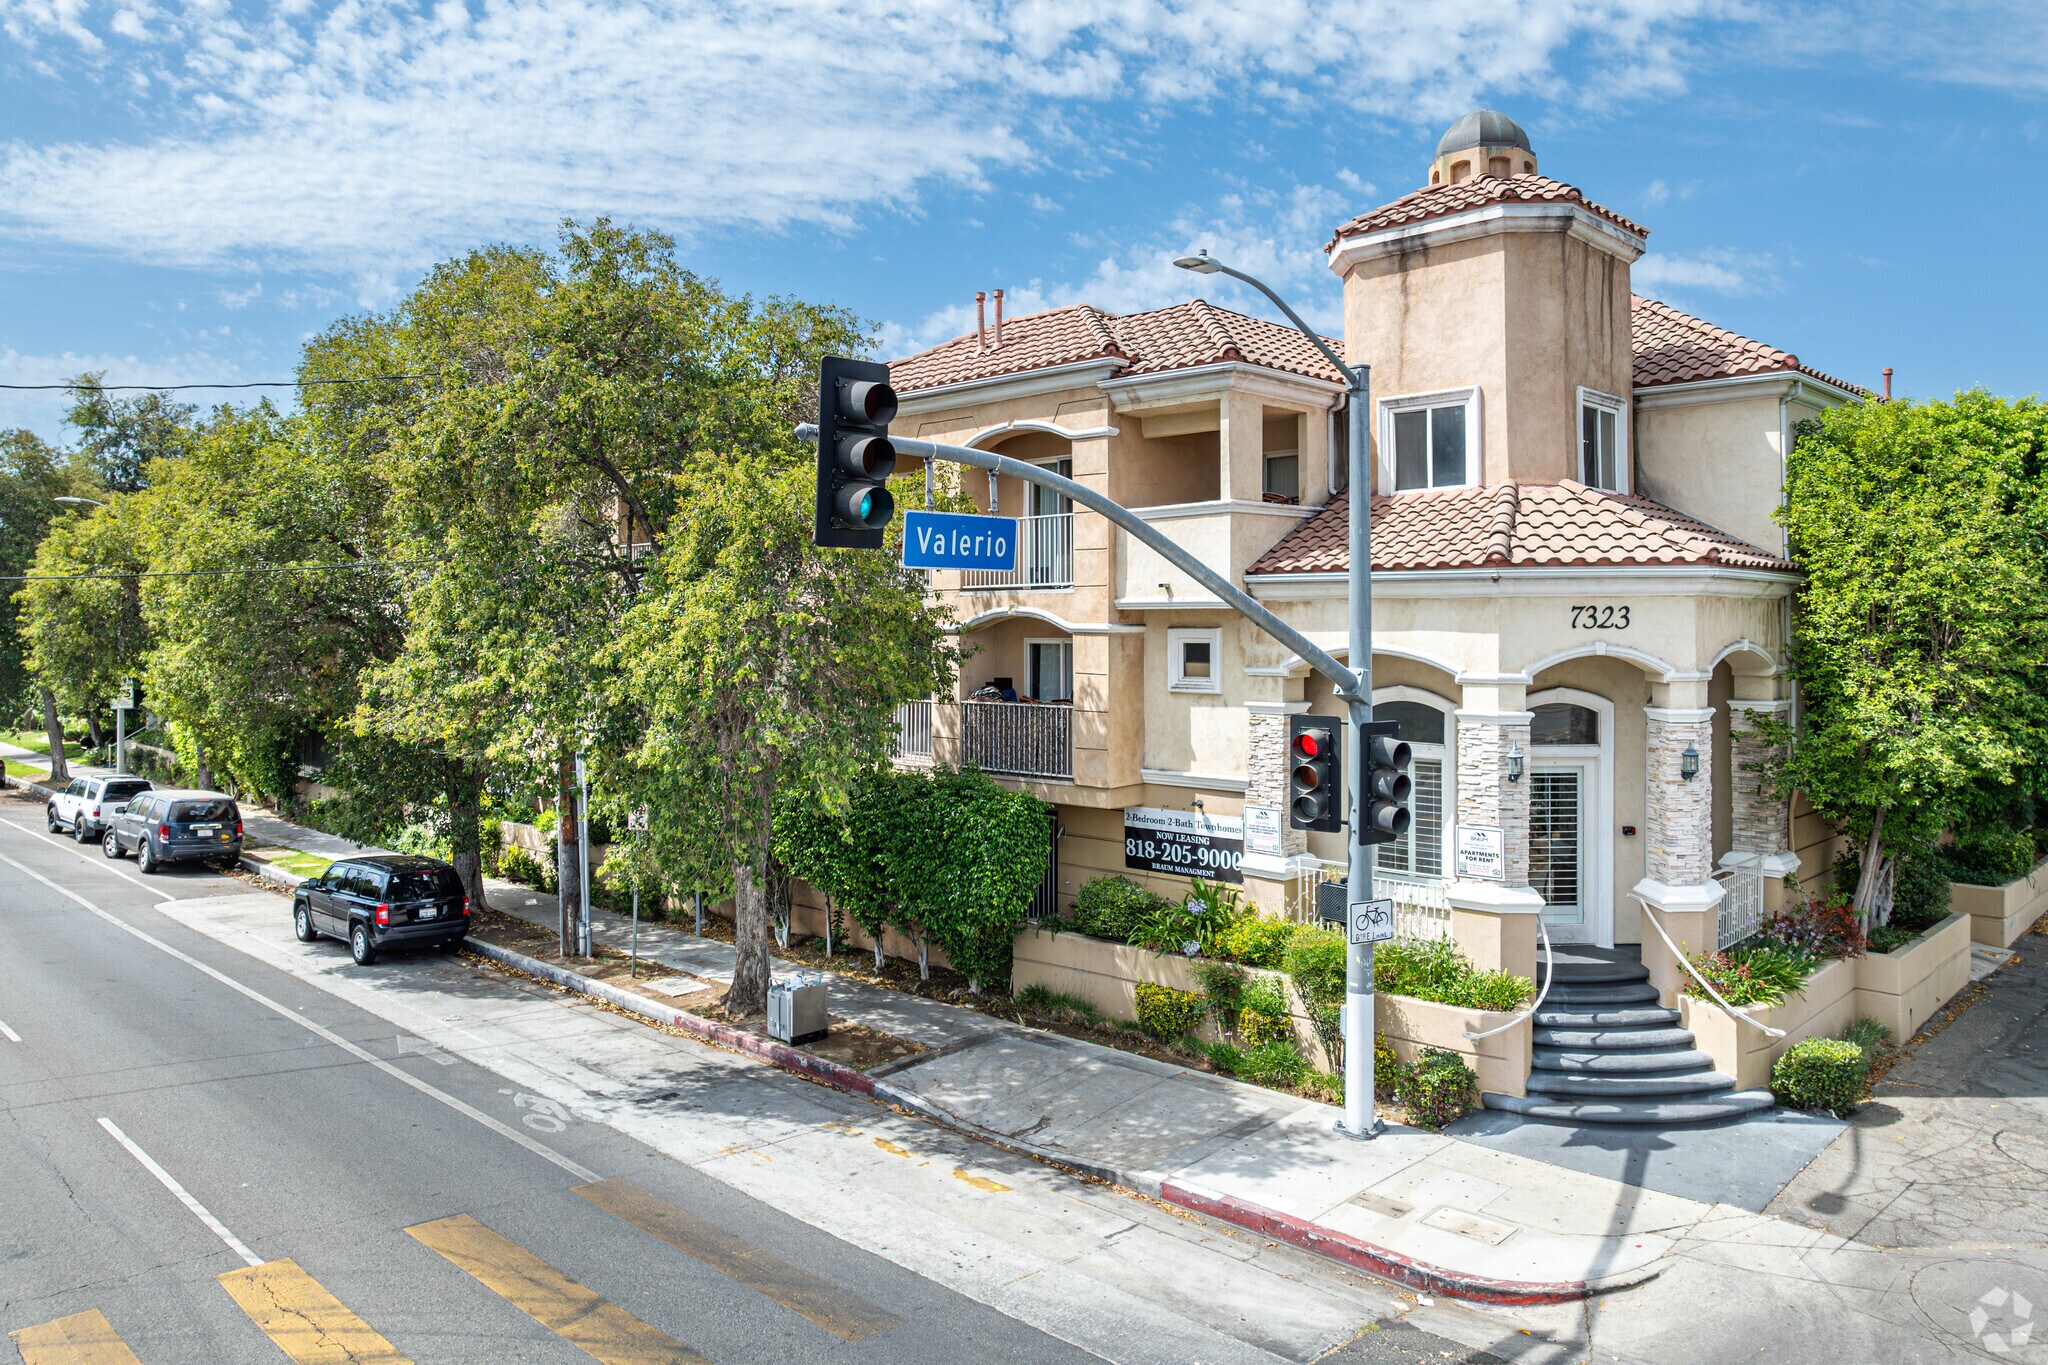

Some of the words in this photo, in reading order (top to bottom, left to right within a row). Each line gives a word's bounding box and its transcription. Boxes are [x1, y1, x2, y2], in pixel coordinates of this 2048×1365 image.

[916, 526, 1007, 558] Valerio
[1571, 605, 1631, 629] 7323
[1125, 812, 1166, 826] 2-Bedroom
[1167, 817, 1194, 829] 2-Bath
[1195, 820, 1243, 834] Townhomes
[1156, 831, 1175, 841] NOW
[1175, 833, 1210, 845] LEASING
[1126, 838, 1243, 871] 818-205-9000
[1460, 850, 1500, 859] APARTMENTS
[1151, 862, 1174, 872] BRAUM
[1174, 866, 1216, 878] MANAGMENT
